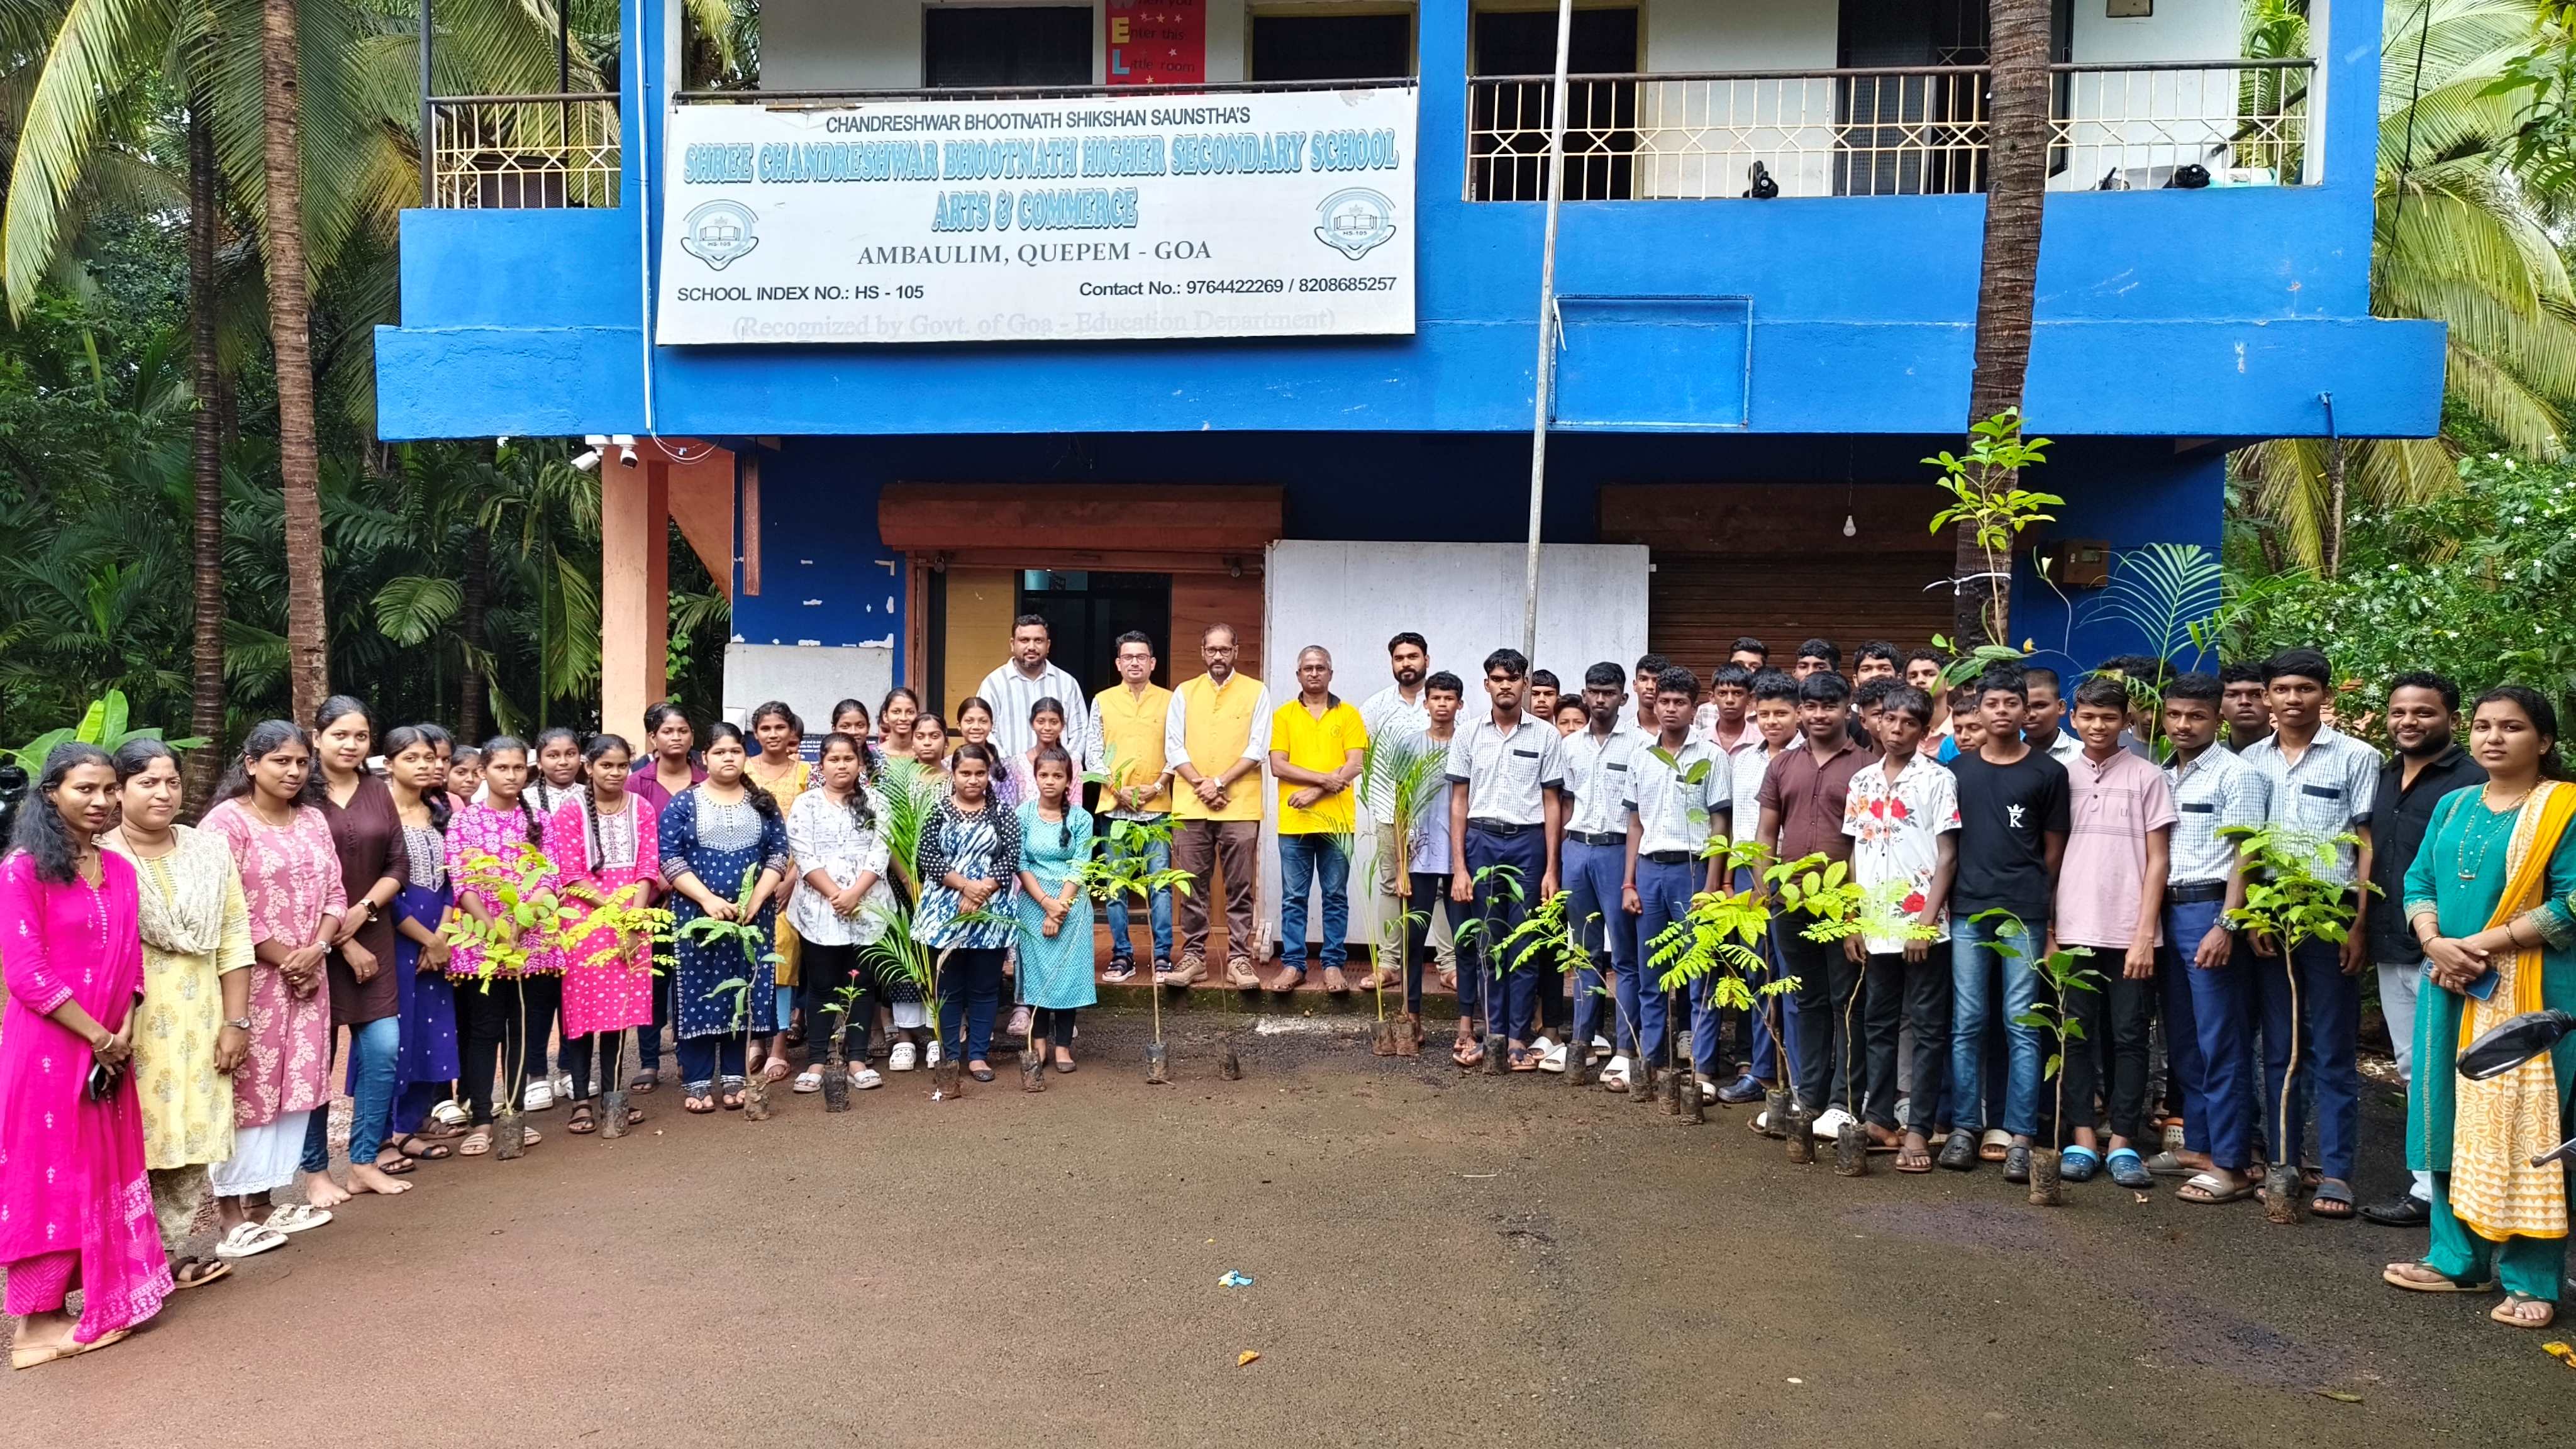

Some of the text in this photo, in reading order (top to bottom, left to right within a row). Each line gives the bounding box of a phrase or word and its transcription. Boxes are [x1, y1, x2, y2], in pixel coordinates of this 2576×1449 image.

[1162, 29, 1185, 41] this
[1160, 60, 1195, 73] room
[826, 106, 1251, 133] CHANDRESHWAR BHOOTNATH SHIKSHAN SAUNSTHA'S
[683, 128, 1400, 184] SHREE CHANDRESHWAR BHOOTNATH HIGHER SECONDARY SCHOOL
[931, 186, 1138, 233] ARTS & COMMERCE
[857, 244, 1009, 267] AMBAULIM,
[1018, 242, 1130, 267] QUEPEM
[1154, 240, 1213, 260] GOA
[677, 286, 752, 303] SCHOOL
[757, 286, 809, 301] INDEX
[814, 285, 850, 301] NO.:
[855, 285, 880, 300] HS
[895, 284, 924, 299] 105
[1079, 276, 1397, 297] Contact No.: 9764422269 / 8208685257
[733, 316, 862, 340] (Recognized
[875, 314, 902, 338] by
[909, 314, 970, 336] Govt.
[977, 313, 1004, 335] of
[1008, 313, 1053, 335] Goa
[1075, 311, 1187, 335] Education
[1194, 308, 1336, 333] Department)
